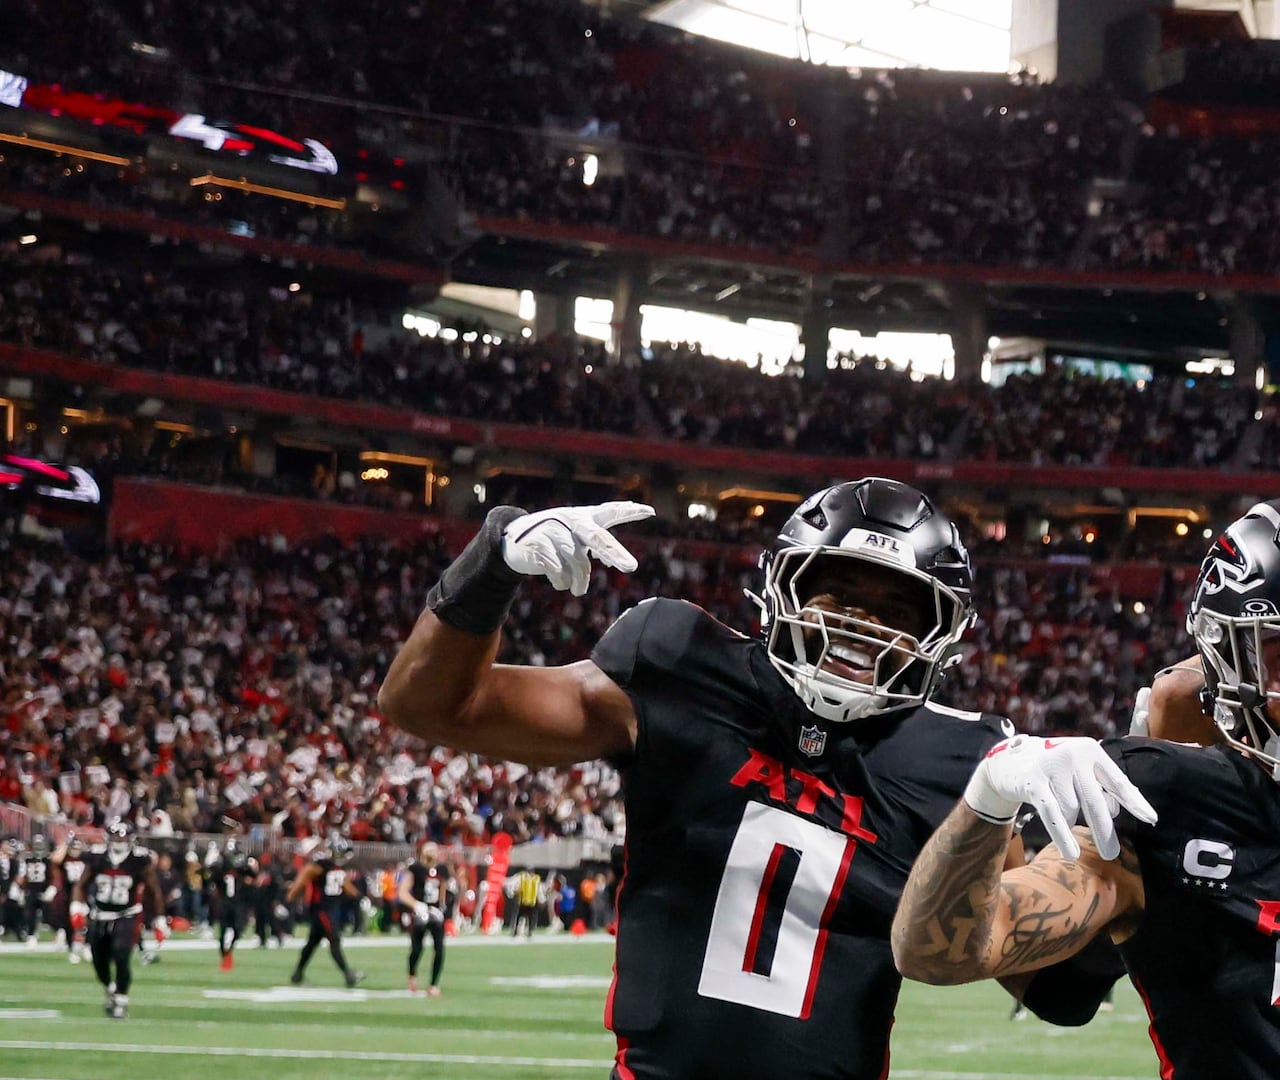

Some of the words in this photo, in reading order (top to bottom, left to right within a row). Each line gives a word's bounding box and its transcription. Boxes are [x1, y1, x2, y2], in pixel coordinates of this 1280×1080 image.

[865, 533, 899, 554] ATL
[730, 748, 878, 843] ATL
[1183, 838, 1234, 879] C
[698, 801, 858, 1020] 0
